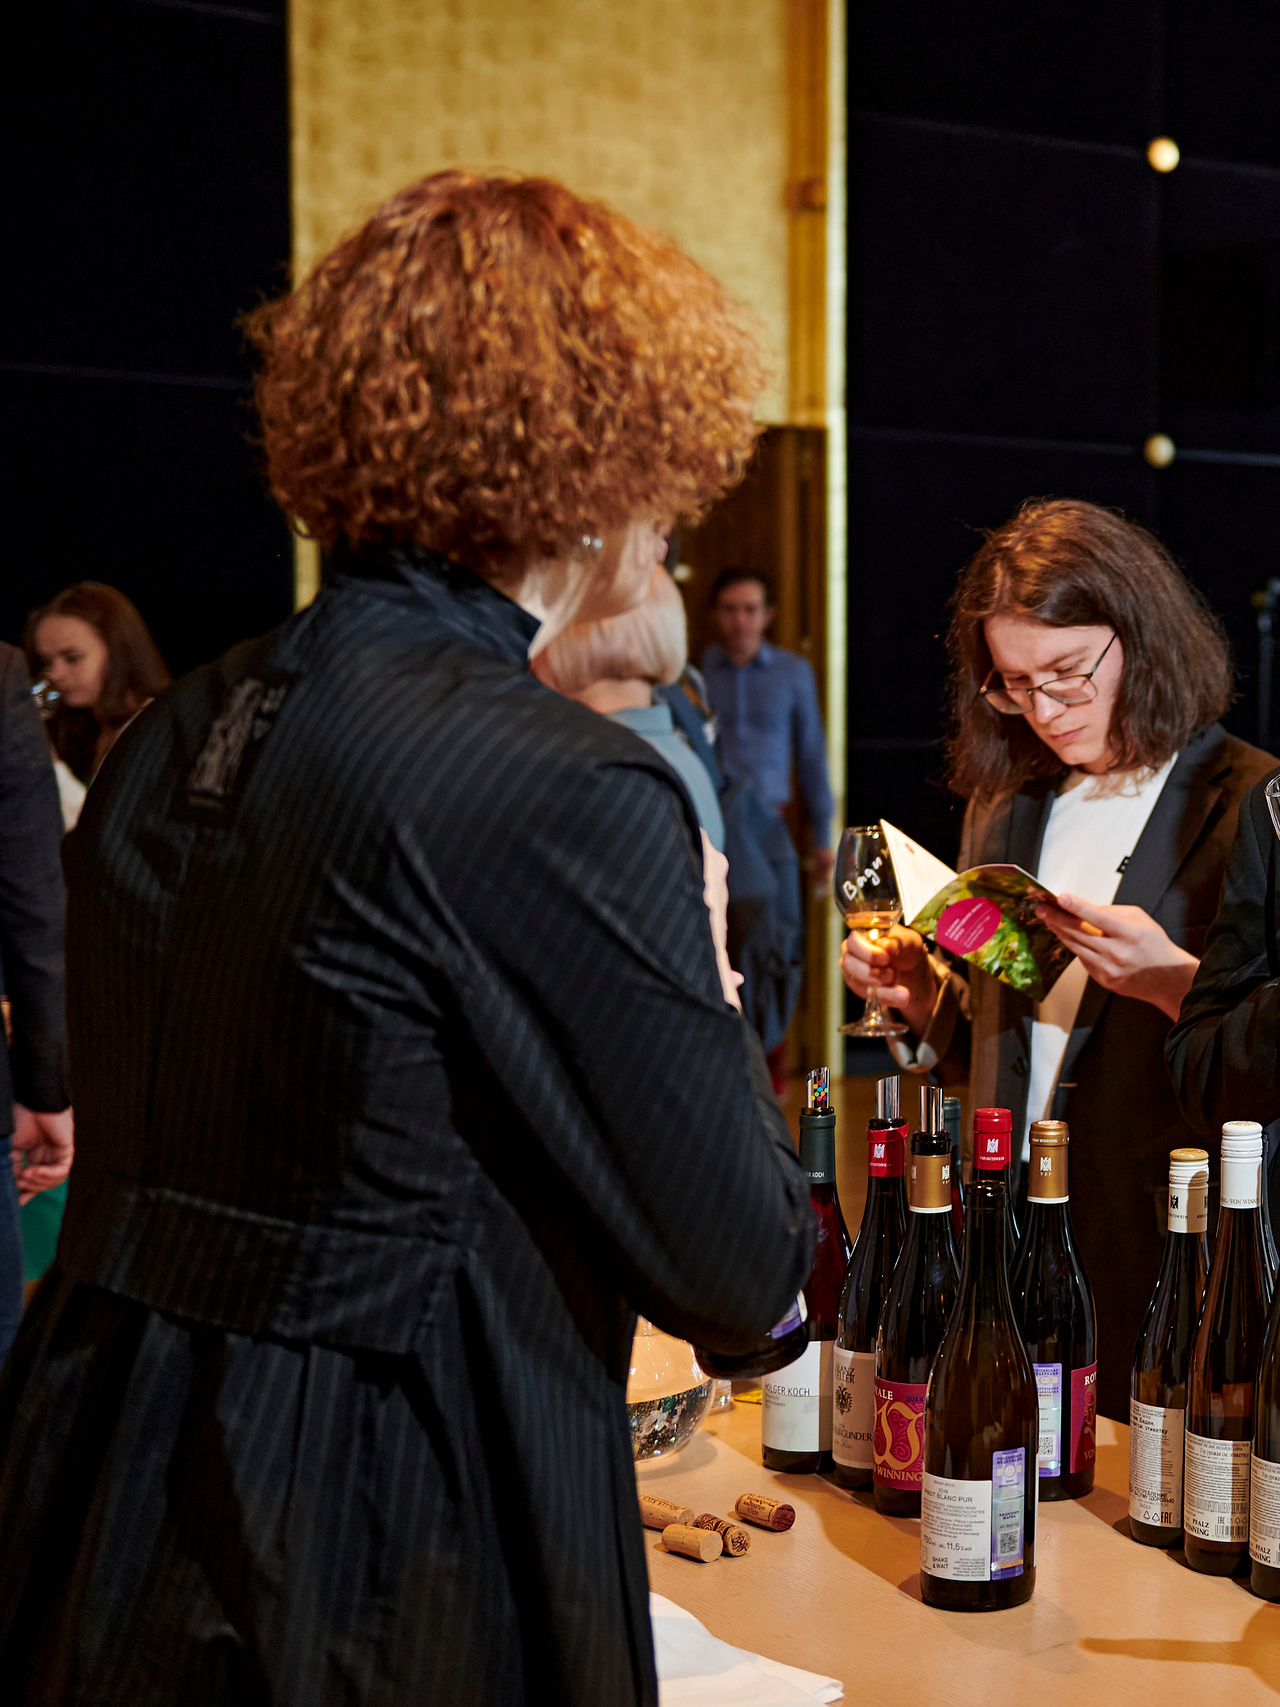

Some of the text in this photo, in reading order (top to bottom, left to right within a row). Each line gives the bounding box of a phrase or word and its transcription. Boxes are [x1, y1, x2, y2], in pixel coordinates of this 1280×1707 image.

[788, 1386, 810, 1397] KOCH
[877, 1469, 923, 1482] WINNING
[936, 1492, 957, 1502] BLANC
[1192, 1518, 1209, 1528] PFALZ
[1255, 1544, 1271, 1555] PFALZ
